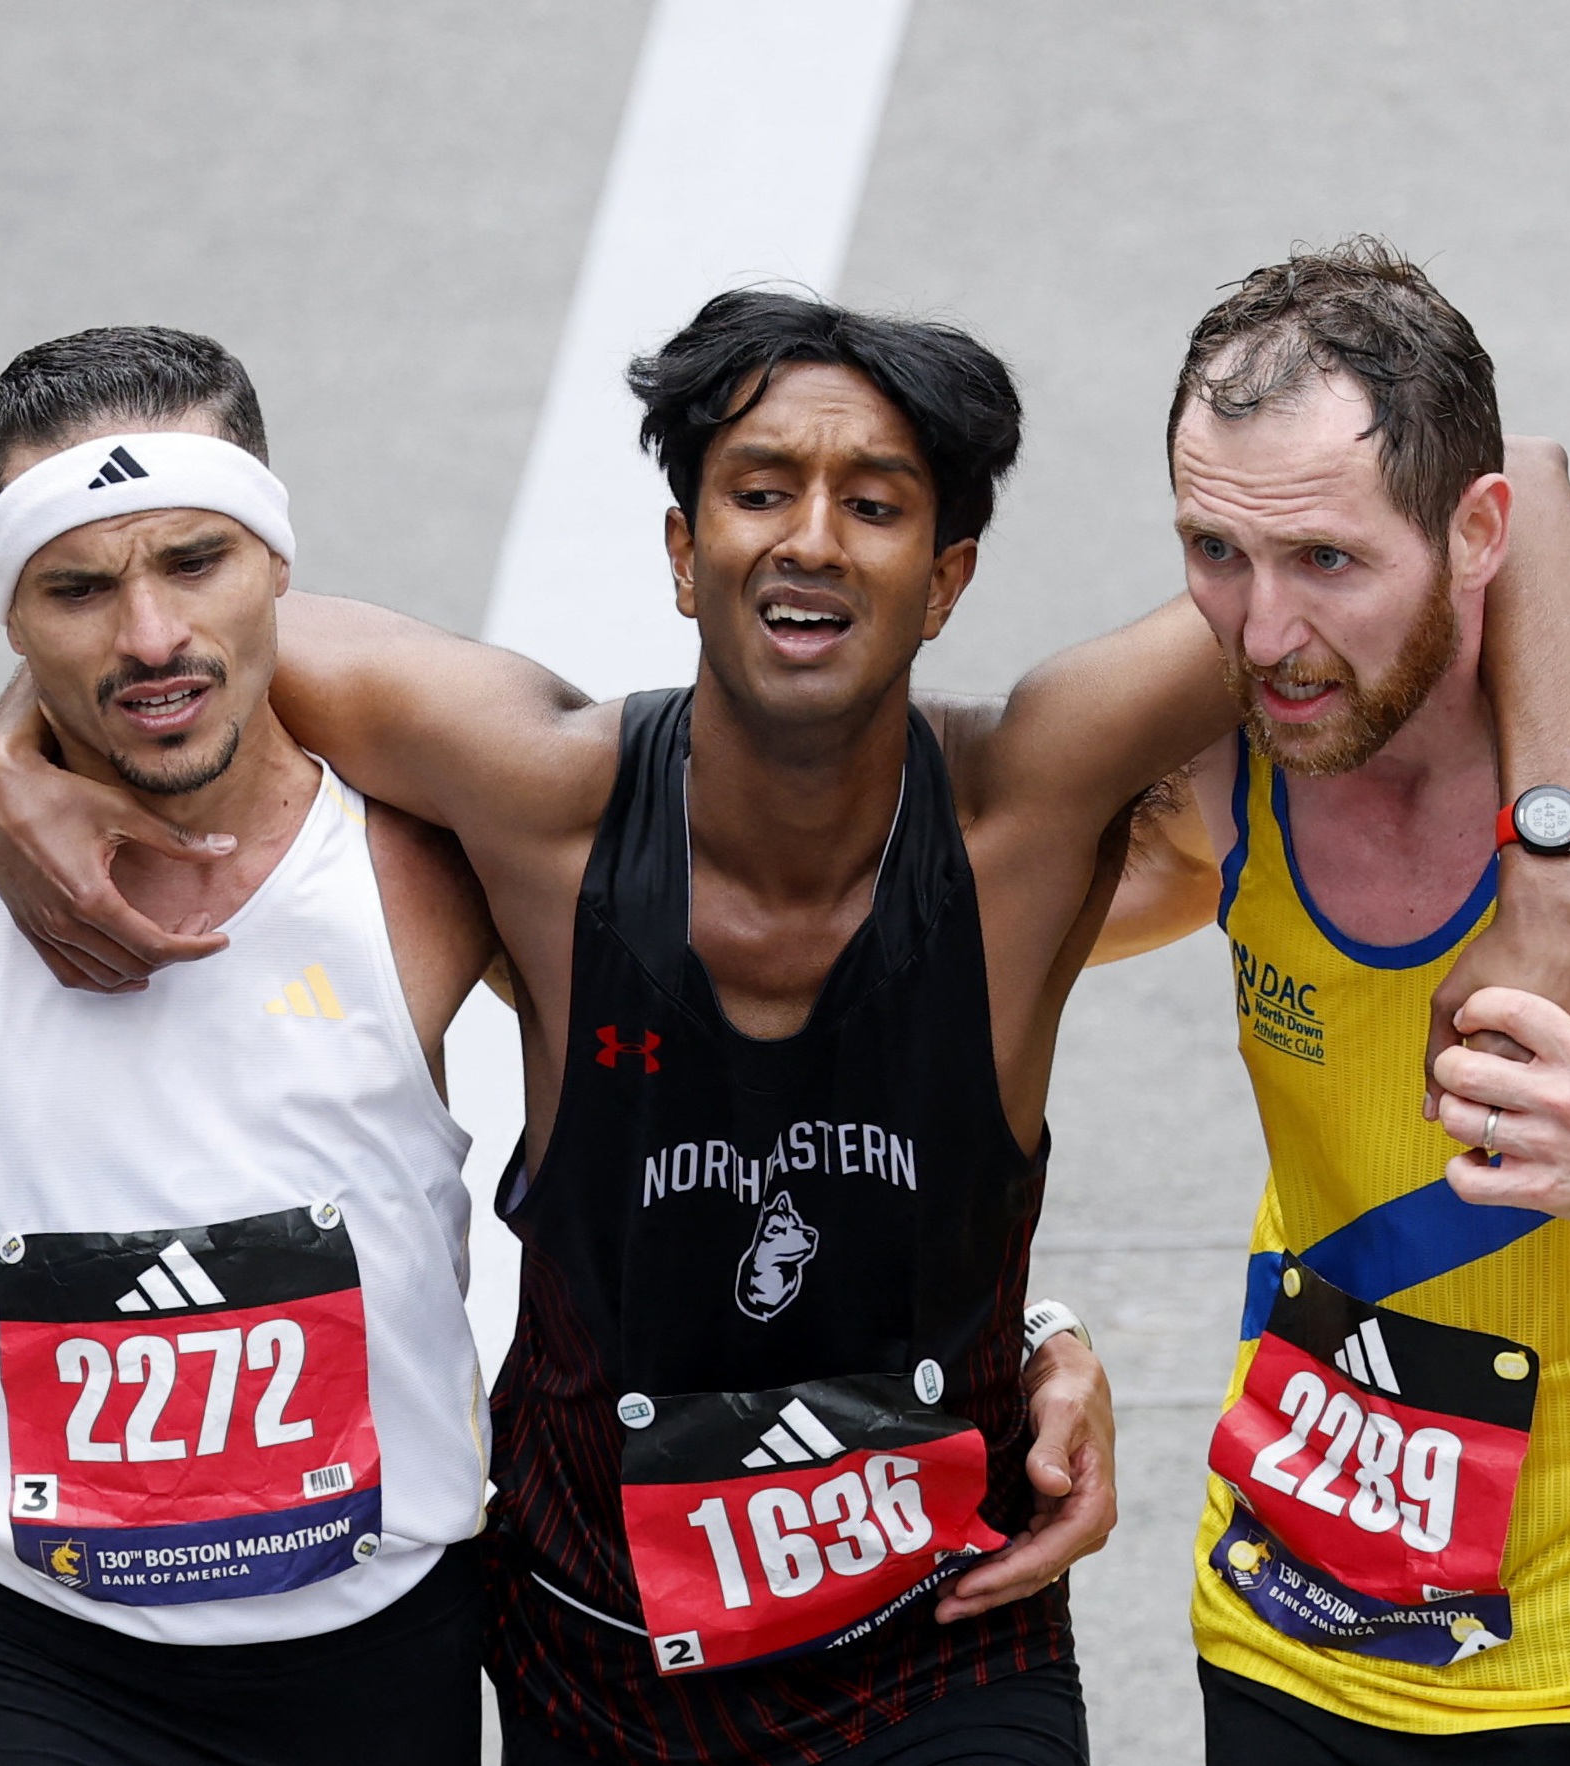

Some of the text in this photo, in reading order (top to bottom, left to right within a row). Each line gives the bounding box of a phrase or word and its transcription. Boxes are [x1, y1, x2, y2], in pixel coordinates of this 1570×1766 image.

[1254, 1018, 1324, 1059] Athletic Club
[1256, 998, 1324, 1041] North Down
[55, 1318, 314, 1463] 2272
[1249, 1370, 1463, 1553] 2289
[21, 1481, 48, 1512] 3
[145, 1542, 230, 1569] BOSTON
[236, 1519, 351, 1558] MARATHON
[687, 1454, 934, 1610] 1636
[102, 1563, 251, 1586] BANK OF AMERICA
[1268, 1585, 1376, 1638] BANK OF AMERICA
[1305, 1581, 1358, 1625] BOSTON
[665, 1638, 693, 1666] 2
